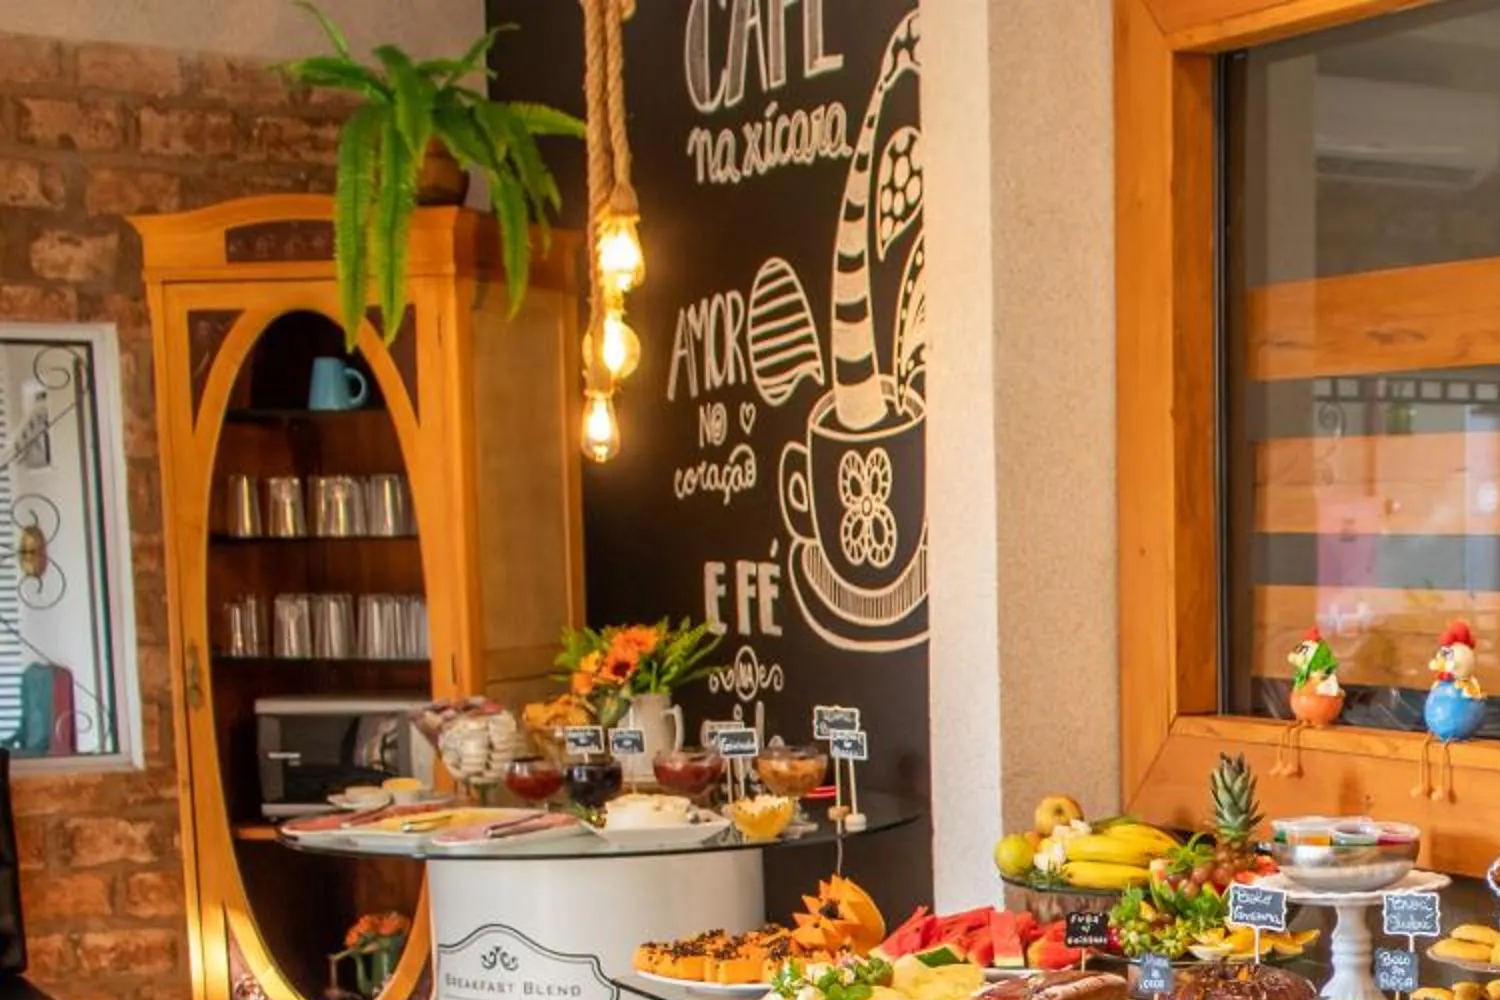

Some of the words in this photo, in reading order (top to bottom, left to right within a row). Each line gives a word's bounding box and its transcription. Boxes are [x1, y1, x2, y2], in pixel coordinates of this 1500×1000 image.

[687, 126, 741, 184] na
[742, 101, 853, 176] xícara
[667, 290, 747, 401] AMOR
[699, 402, 728, 448] NO
[674, 443, 757, 506] coração
[704, 561, 728, 636] E
[736, 538, 783, 637] FÉ
[523, 980, 582, 997] BLEND
